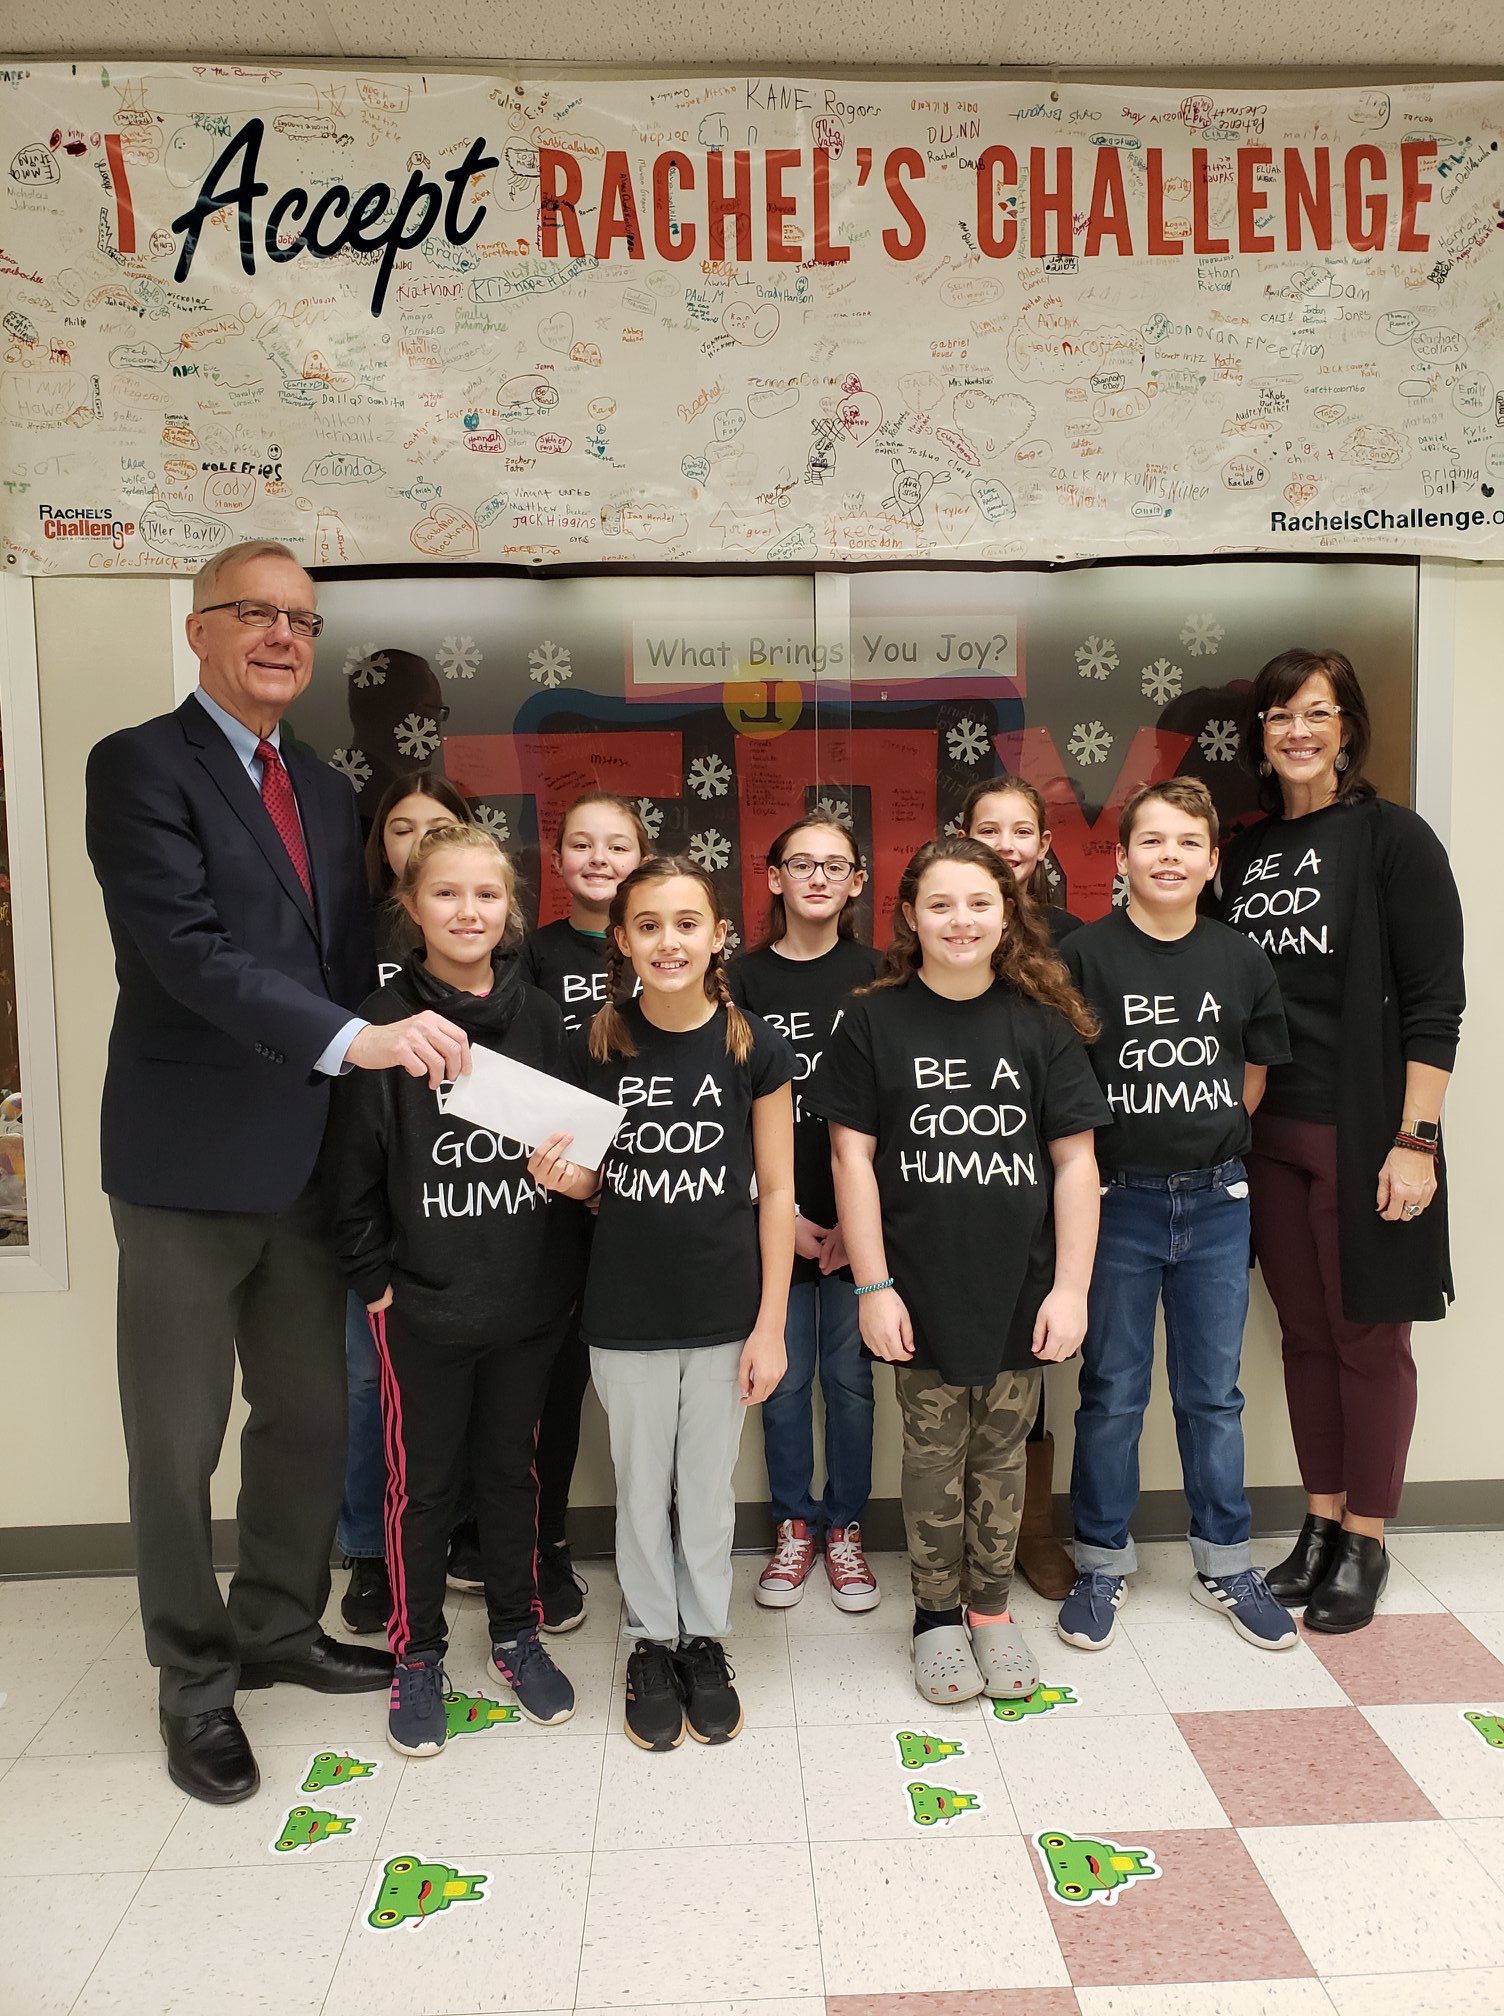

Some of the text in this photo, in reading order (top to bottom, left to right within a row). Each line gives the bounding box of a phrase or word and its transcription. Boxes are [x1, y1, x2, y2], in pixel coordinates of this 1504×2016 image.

[747, 79, 811, 111] KANE
[927, 146, 958, 162] Rachel
[105, 134, 135, 253] I
[172, 118, 499, 317] Accept
[540, 146, 925, 262] RACHEL'S
[977, 142, 1437, 258] CHALLENGE
[1197, 267, 1240, 279] Ethan
[400, 341, 439, 355] Natalie
[312, 463, 374, 477] Yolanda
[211, 478, 251, 496] Cody
[39, 504, 112, 520] RACHEL'S
[44, 519, 135, 549] Challenge
[146, 521, 175, 538] Tyler
[647, 633, 1008, 673] What Brings You Joy?
[1242, 848, 1322, 886] BE A
[563, 974, 609, 1003] BE
[1123, 992, 1222, 1026] BE A
[1119, 1035, 1220, 1072] GOOD
[914, 1057, 1021, 1090] BE A
[617, 1074, 723, 1107] BE A
[1107, 1078, 1239, 1114] HUMAN.
[612, 1121, 724, 1155] GOOD
[910, 1104, 1027, 1139] GOOD
[432, 1128, 536, 1169] GOO
[606, 1159, 728, 1204] HUMAN.
[901, 1151, 1038, 1187] HUMAN.
